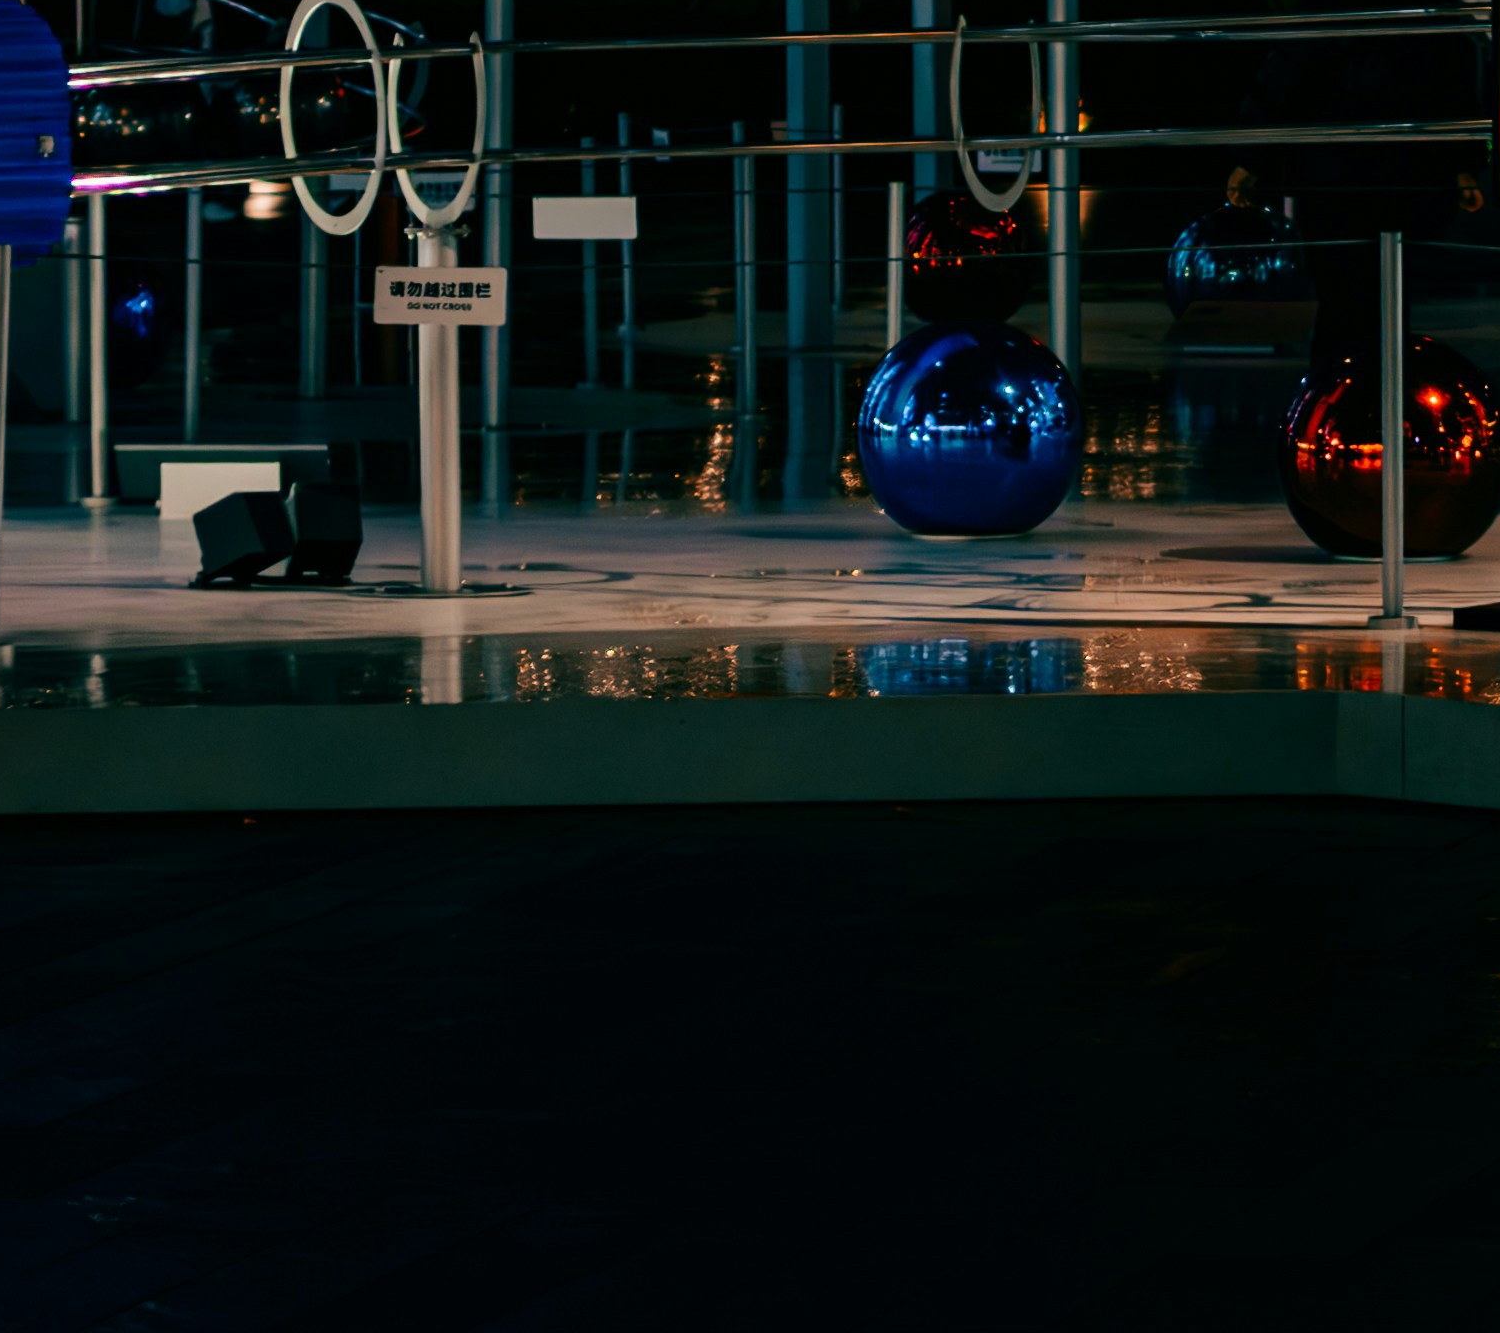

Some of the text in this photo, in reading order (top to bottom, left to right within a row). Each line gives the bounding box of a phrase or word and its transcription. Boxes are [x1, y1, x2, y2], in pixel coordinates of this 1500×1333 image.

[389, 281, 491, 298] 请勿越过围栏
[407, 302, 472, 311] DO NOT CROSS
